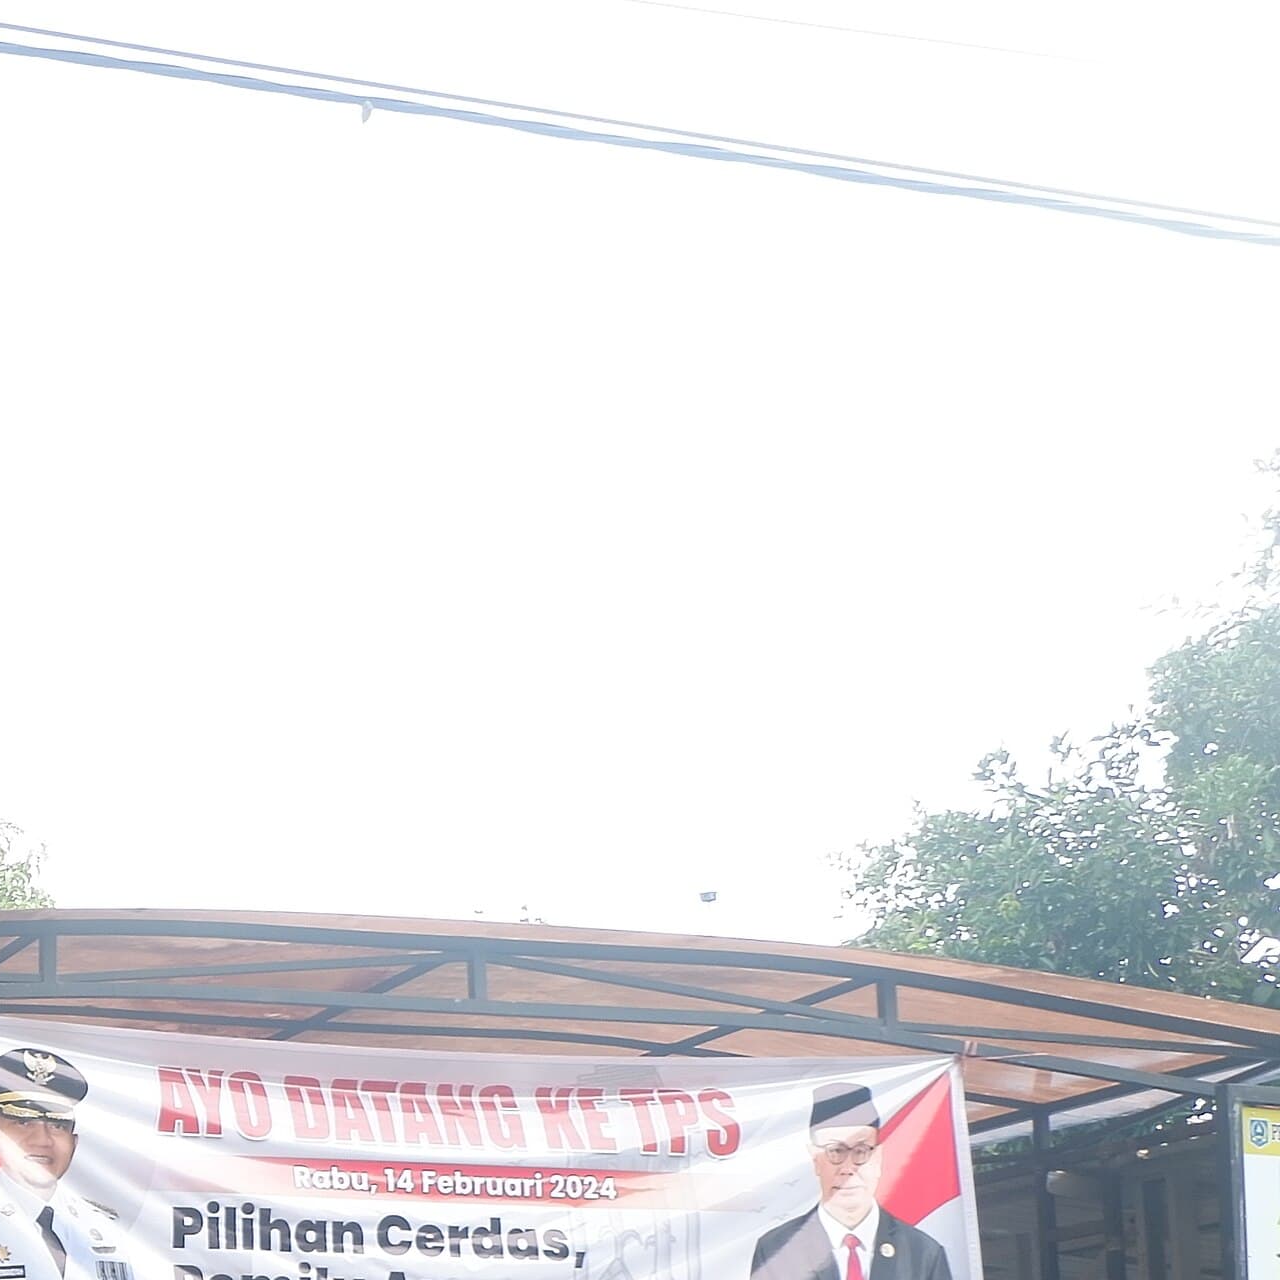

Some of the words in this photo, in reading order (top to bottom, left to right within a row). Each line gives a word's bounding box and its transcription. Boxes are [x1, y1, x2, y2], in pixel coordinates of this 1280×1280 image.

[156, 1066, 272, 1139] AYO
[283, 1073, 520, 1150] DATANG
[533, 1085, 619, 1152] KE
[619, 1087, 741, 1158] TPS
[292, 1165, 378, 1195] Rabu,
[383, 1167, 413, 1193] 14
[421, 1169, 542, 1198] Februari
[550, 1174, 617, 1199] 2024
[172, 1201, 365, 1254] Pilihan
[376, 1215, 587, 1269] Cerdas,
